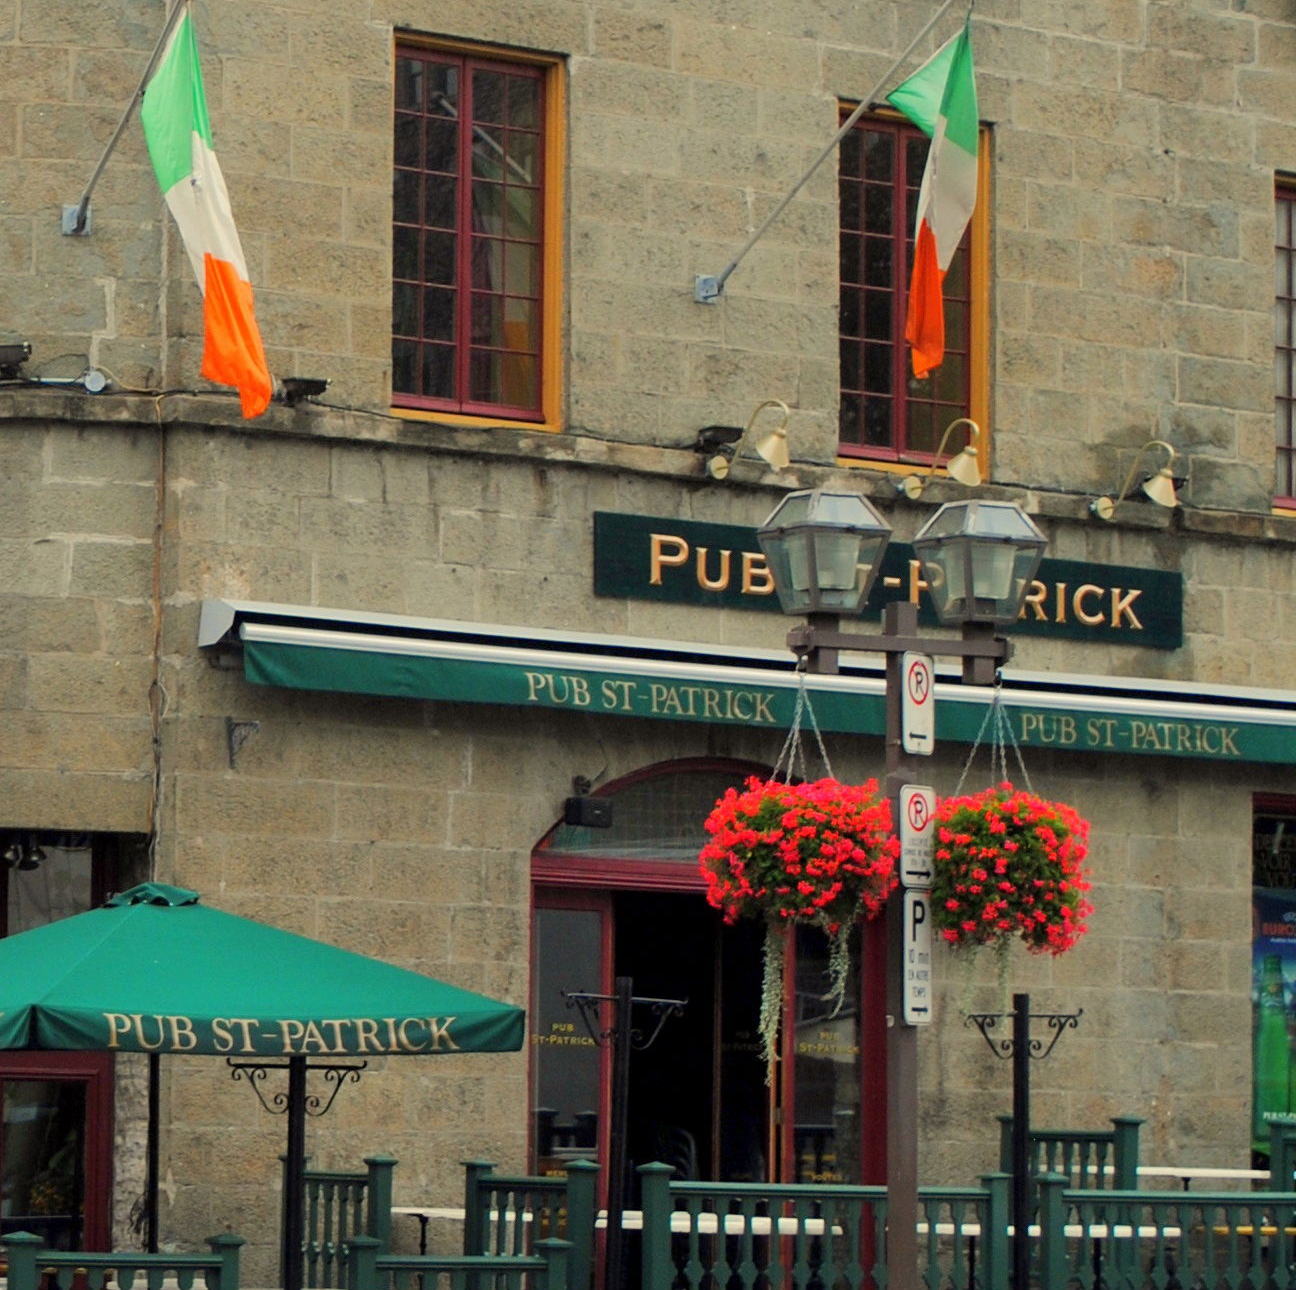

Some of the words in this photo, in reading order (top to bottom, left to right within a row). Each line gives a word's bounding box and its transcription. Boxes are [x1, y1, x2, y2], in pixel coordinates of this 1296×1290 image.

[648, 533, 777, 596] PUB
[524, 672, 591, 706] PUB
[600, 680, 777, 724] ST-PATRICK
[1020, 713, 1077, 746] PUB
[1086, 718, 1242, 756] ST-PATRICK
[103, 1012, 197, 1050] PUB
[210, 1015, 461, 1054] ST-PATRICK
[552, 1022, 575, 1033] PUB
